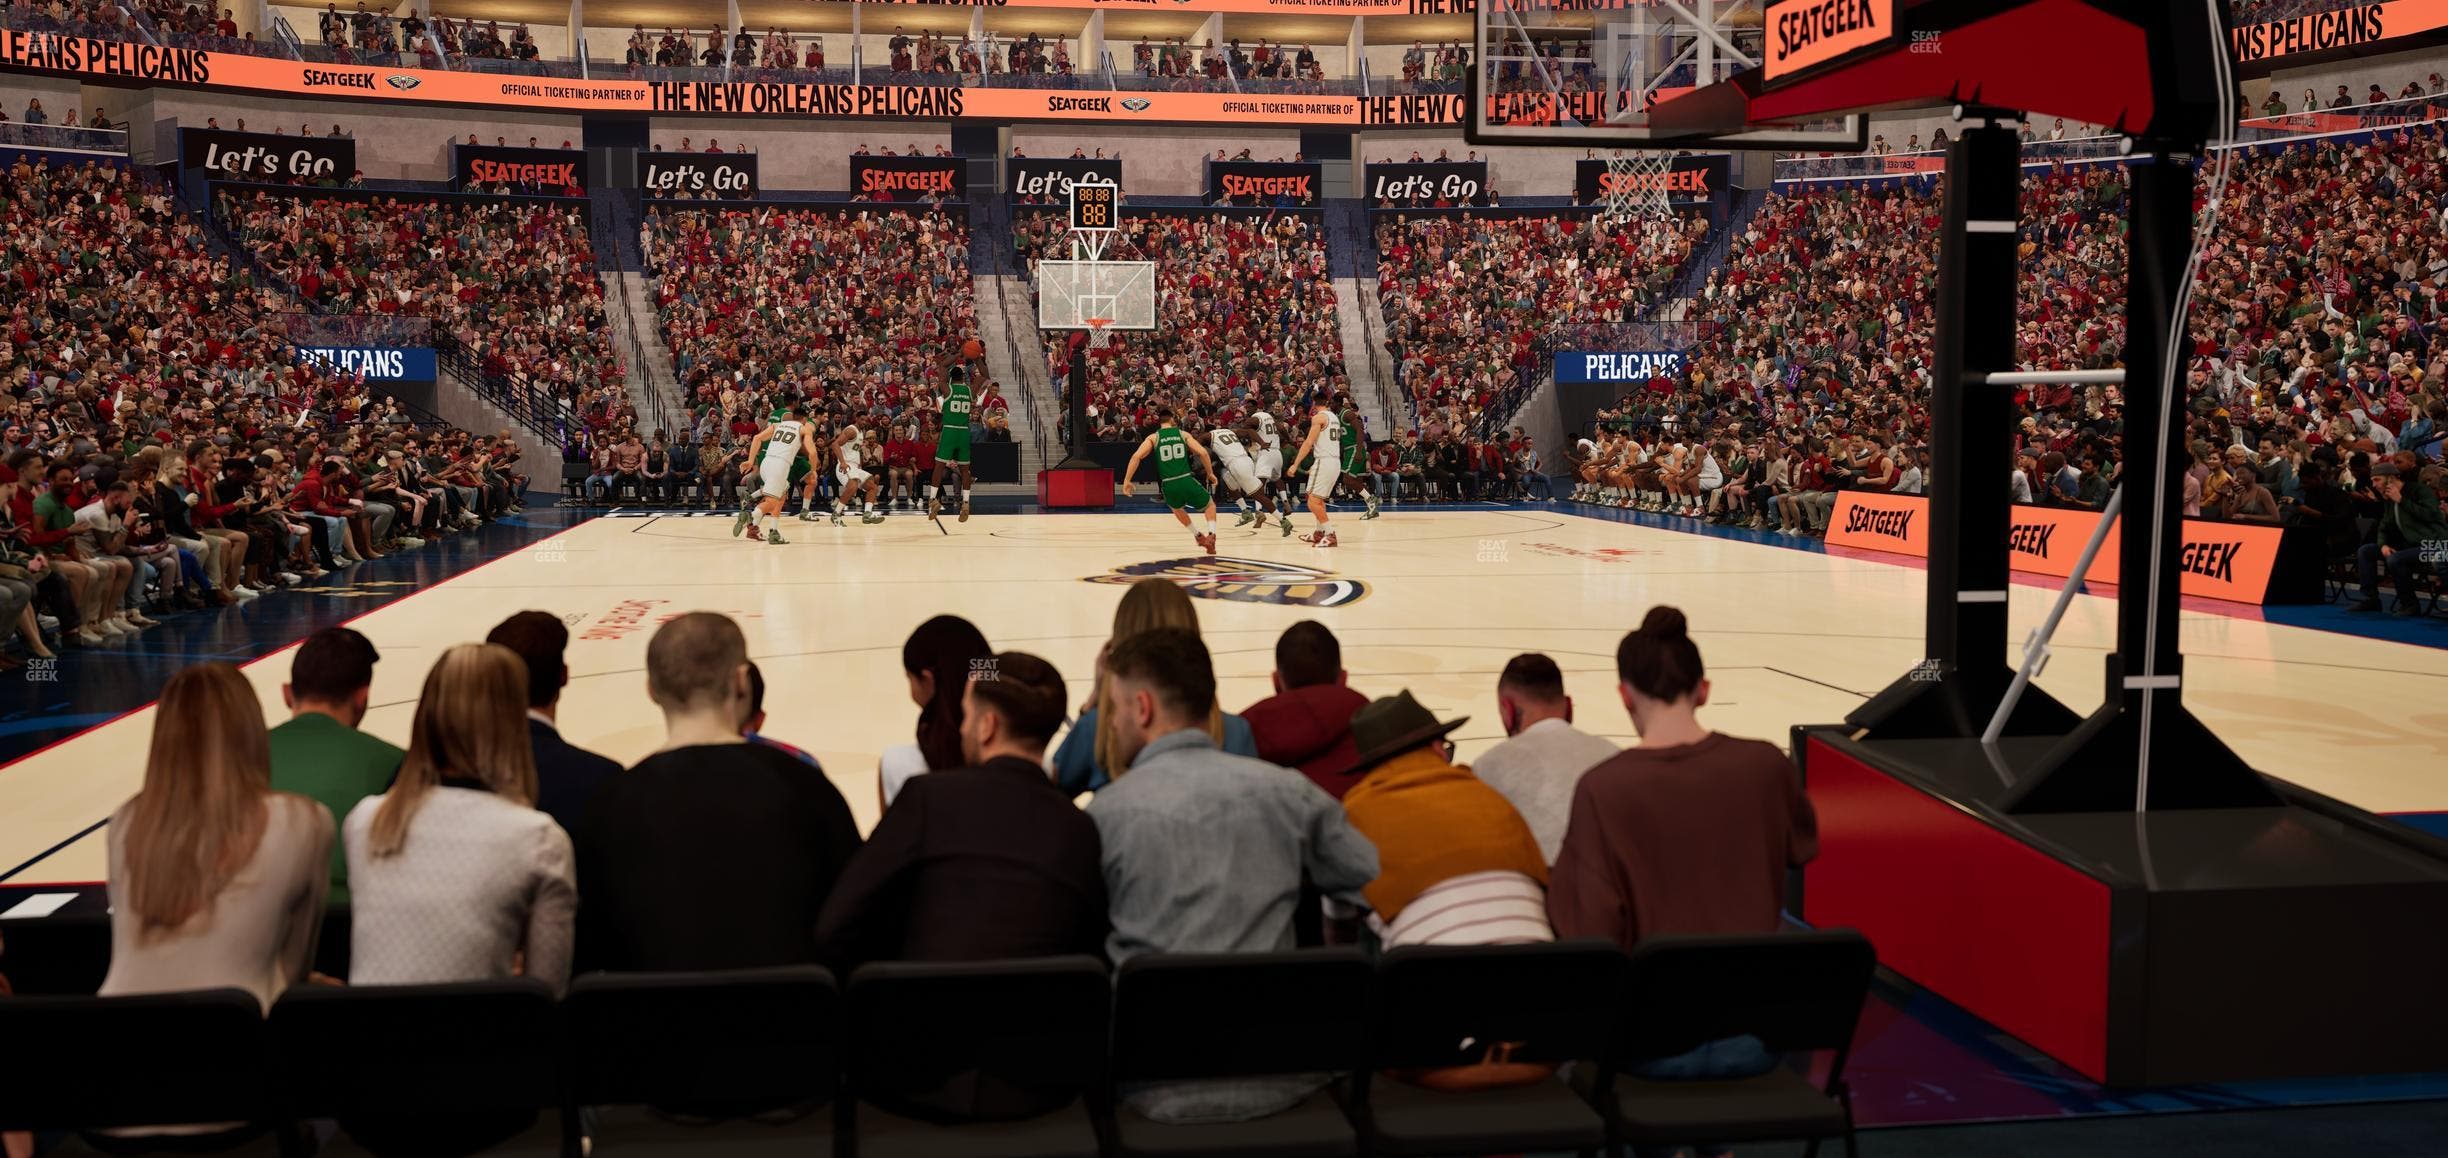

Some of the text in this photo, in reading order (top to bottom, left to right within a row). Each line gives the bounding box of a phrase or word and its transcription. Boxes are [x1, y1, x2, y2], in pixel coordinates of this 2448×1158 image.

[1777, 0, 1875, 61] SEATGEEK
[2270, 4, 2383, 56] PELICANS
[87, 39, 209, 83] PELICANS
[303, 69, 376, 90] SEATGEEK
[502, 82, 963, 117] OFFICIAL TICKETING PARTNER OF THE NEW ORLEANS PELICANS
[1048, 95, 1111, 113] SEATGEEK
[1222, 101, 1259, 113] OFFICIAL
[1261, 102, 1303, 115] TICKETING
[1305, 103, 1341, 115] PARTNER
[1343, 104, 1354, 116] OF
[1357, 96, 1395, 123] THE
[1400, 96, 1447, 123] NEW
[1451, 92, 1550, 121] OEANS
[205, 142, 335, 176] Let's Go
[470, 158, 577, 186] SEATGEEK
[646, 164, 749, 190] Let's Go
[861, 168, 955, 192] SEATGEEK
[1016, 170, 1073, 195] Let's
[1222, 174, 1311, 198] SEATGEEK
[1374, 174, 1478, 200] Let's Go
[1599, 168, 1709, 194] SEATGEEK
[1079, 188, 1109, 201] 88 88
[1082, 203, 1106, 225] 88
[950, 400, 971, 413] 00
[773, 430, 796, 444] 00
[1160, 443, 1185, 461] 00
[1845, 504, 1914, 541] SEATGEEK
